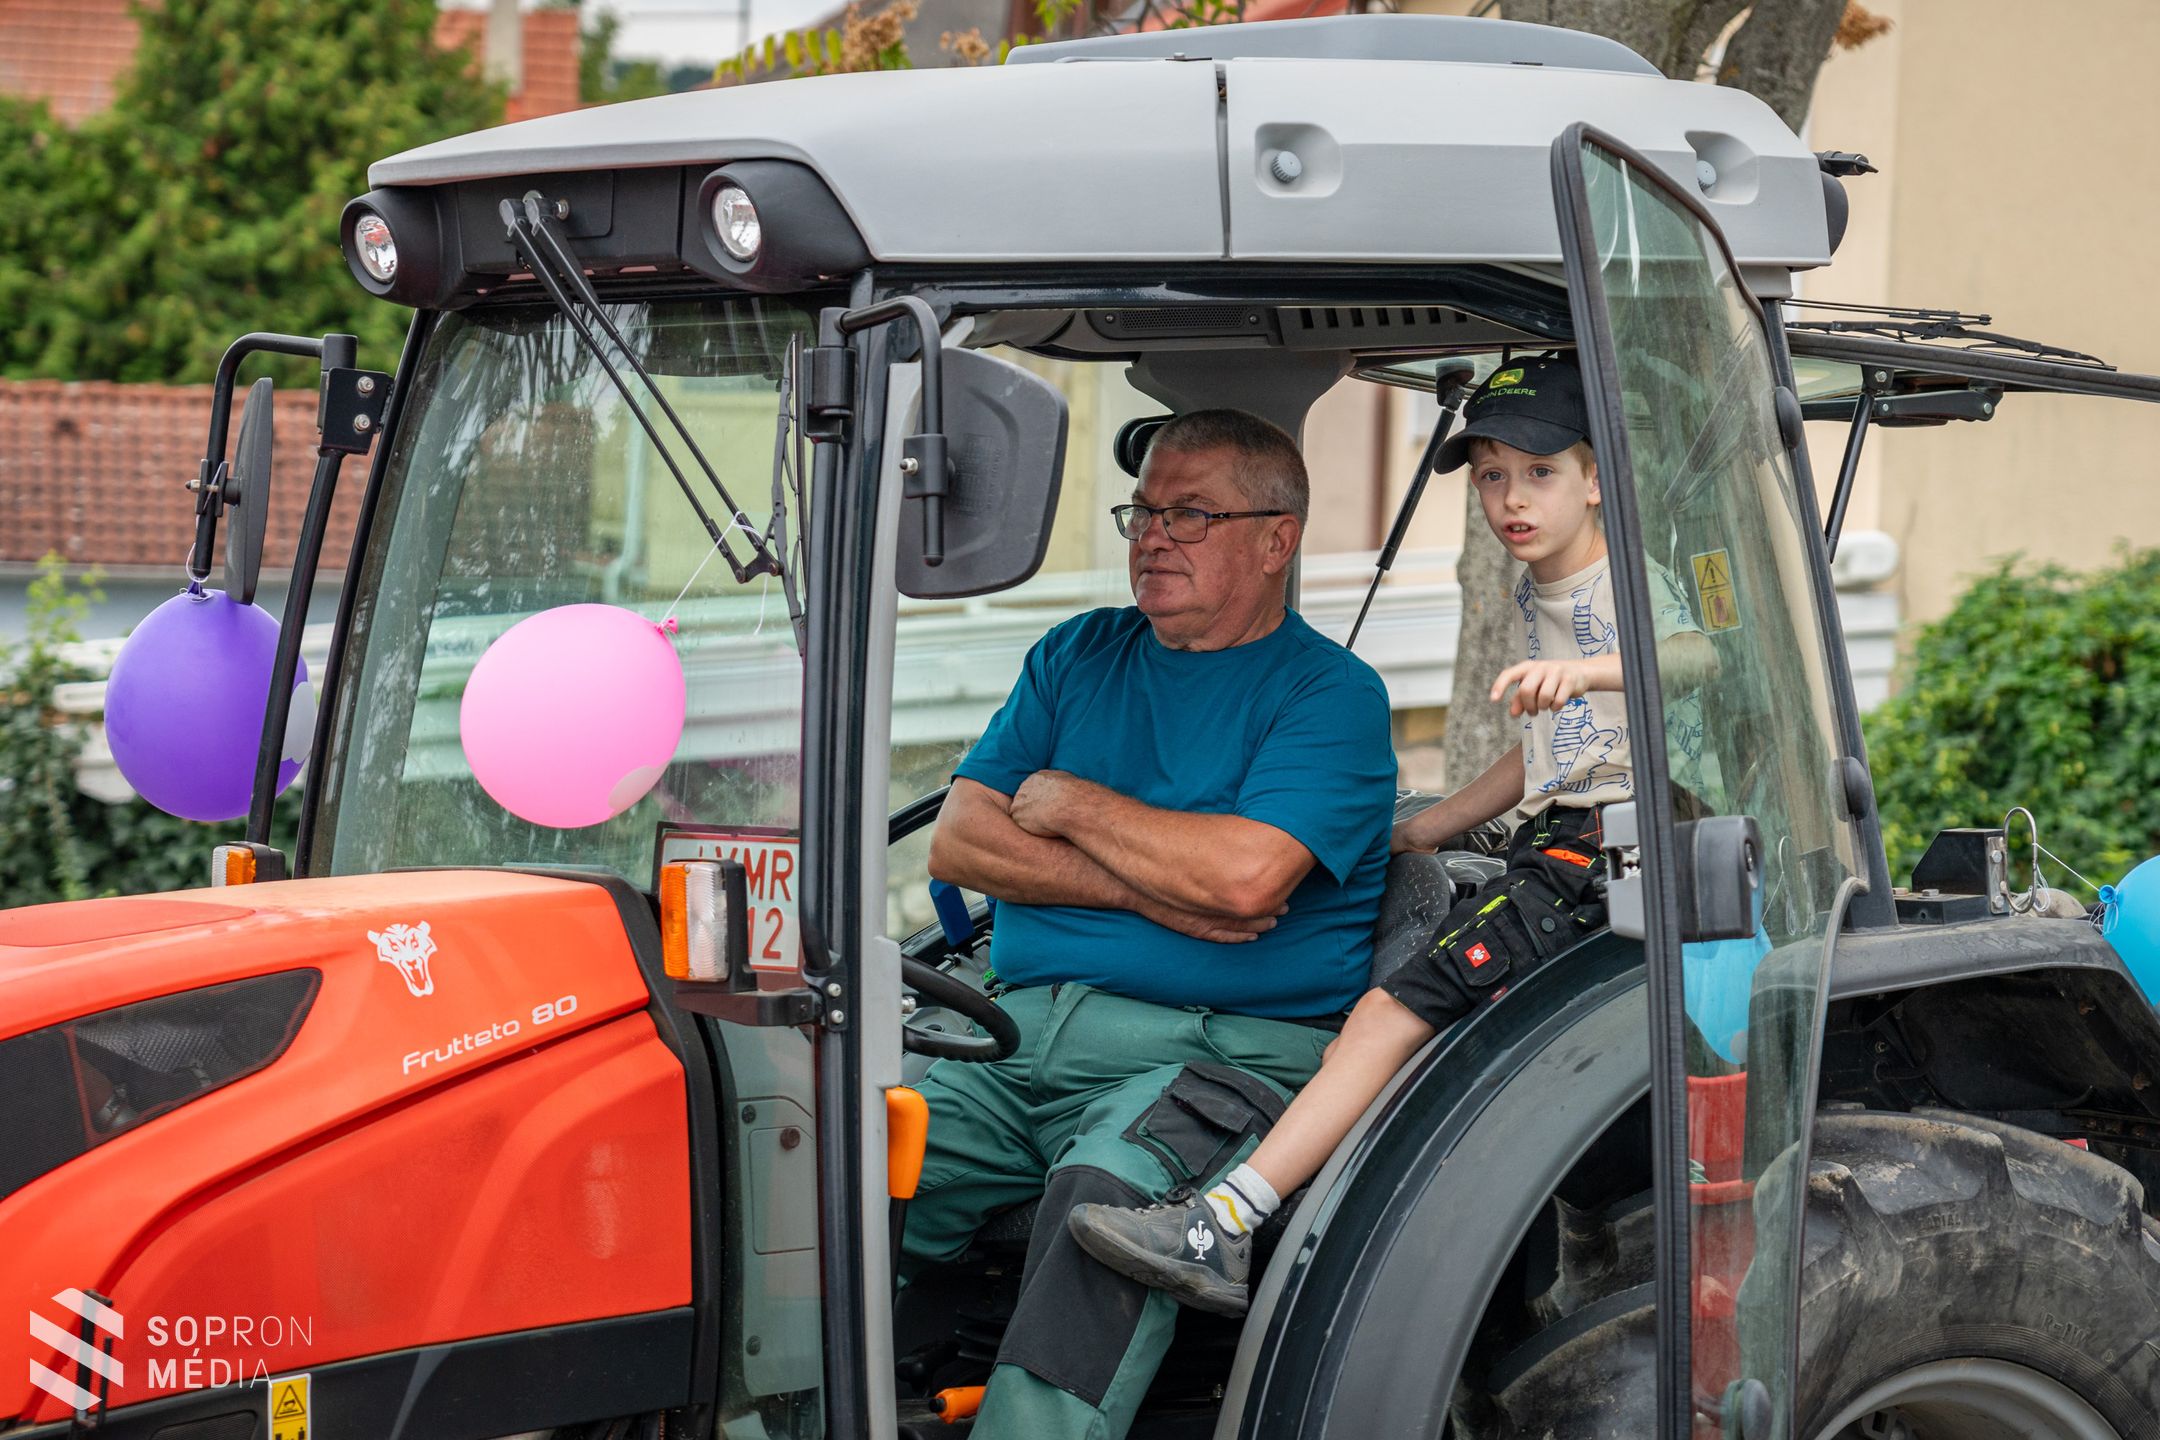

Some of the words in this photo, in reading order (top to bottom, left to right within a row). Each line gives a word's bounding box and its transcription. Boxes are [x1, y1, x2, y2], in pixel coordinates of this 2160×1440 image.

[1498, 387, 1537, 396] DEERE
[403, 1020, 520, 1075] Frutteto
[532, 995, 578, 1025] 80
